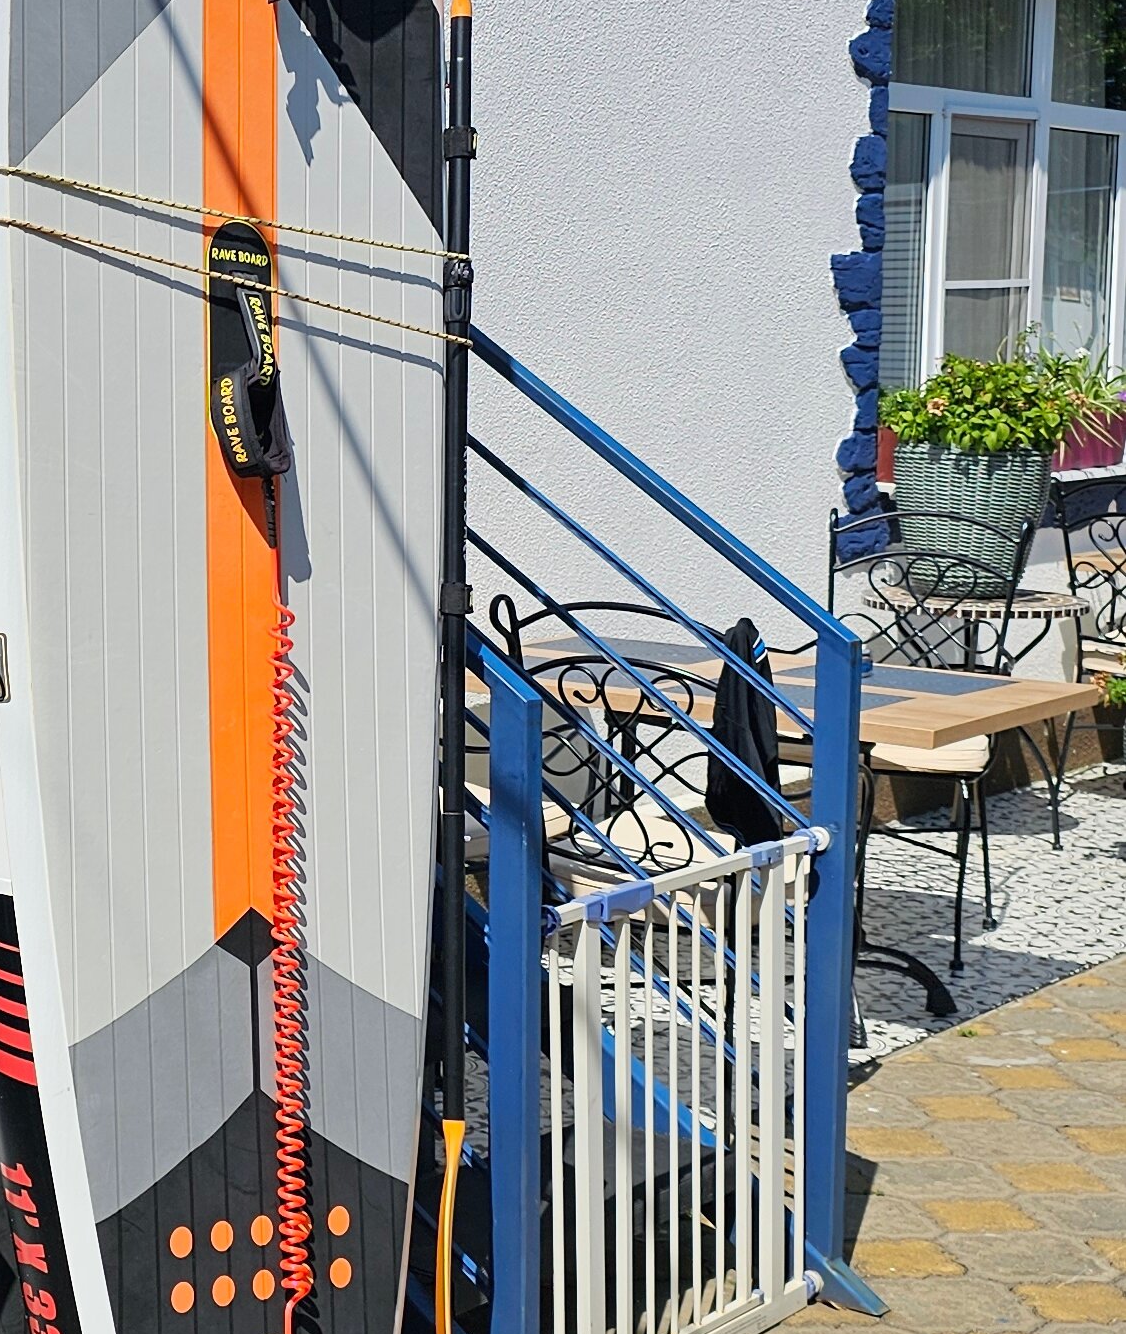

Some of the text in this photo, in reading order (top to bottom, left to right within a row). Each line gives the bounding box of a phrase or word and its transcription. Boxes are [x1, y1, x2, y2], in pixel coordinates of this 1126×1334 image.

[211, 247, 269, 267] RAVE BOARD
[248, 296, 269, 333] RAVE
[220, 377, 249, 463] RAVE BOARD
